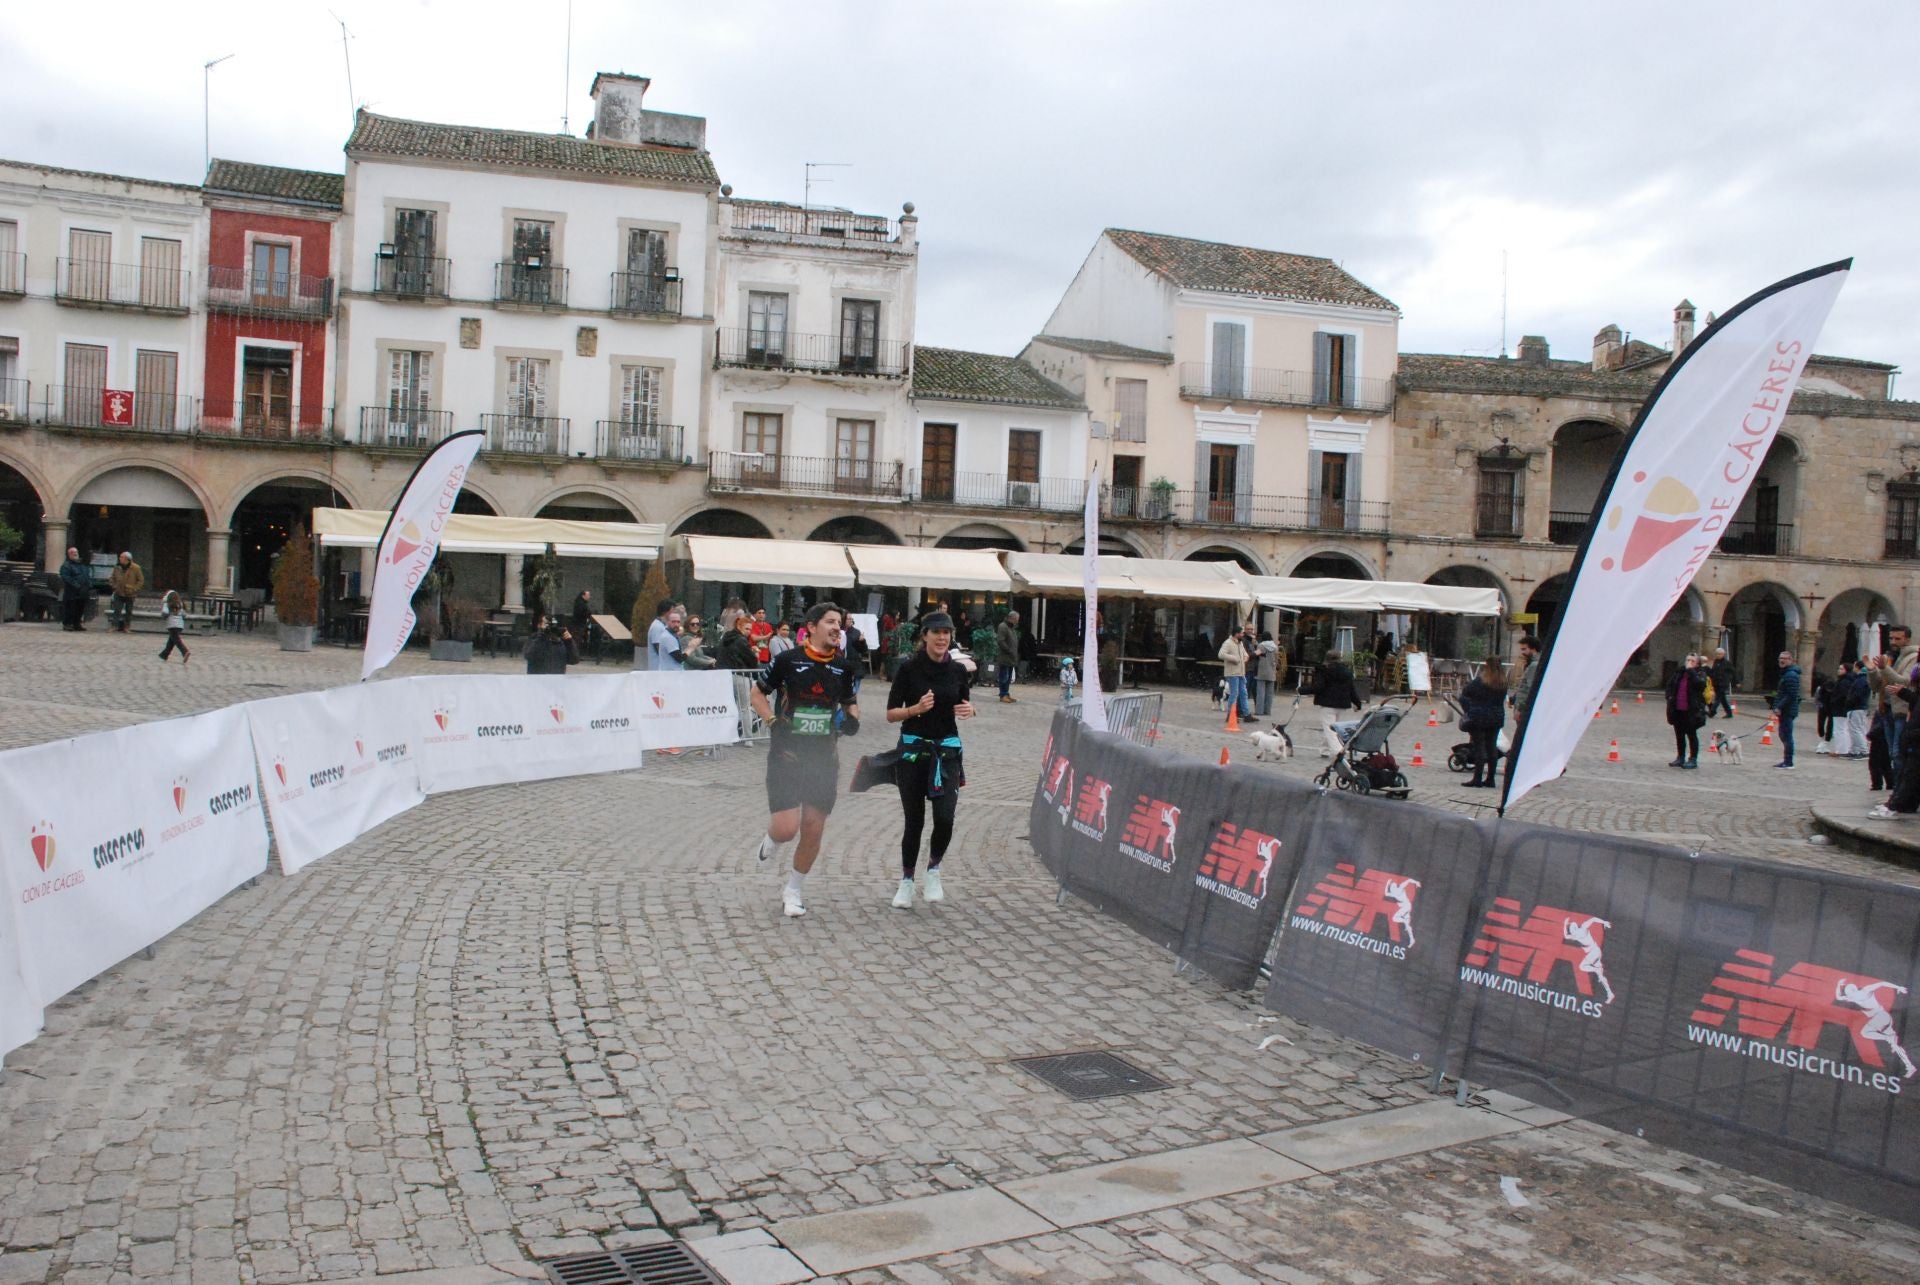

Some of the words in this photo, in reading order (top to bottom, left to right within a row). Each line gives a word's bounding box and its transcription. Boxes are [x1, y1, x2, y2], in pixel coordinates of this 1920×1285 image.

[1701, 496, 1735, 532] DE
[1723, 340, 1802, 484] CÁCERES
[421, 535, 436, 557] DE
[800, 720, 825, 732] 205
[1119, 842, 1172, 873] www.musicrun.es
[1195, 874, 1261, 910] www.musicrun.es
[1291, 914, 1406, 961] www.musicrun.es
[1460, 966, 1603, 1018] www.musicrun.es
[1687, 1023, 1901, 1094] www.musicrun.es
